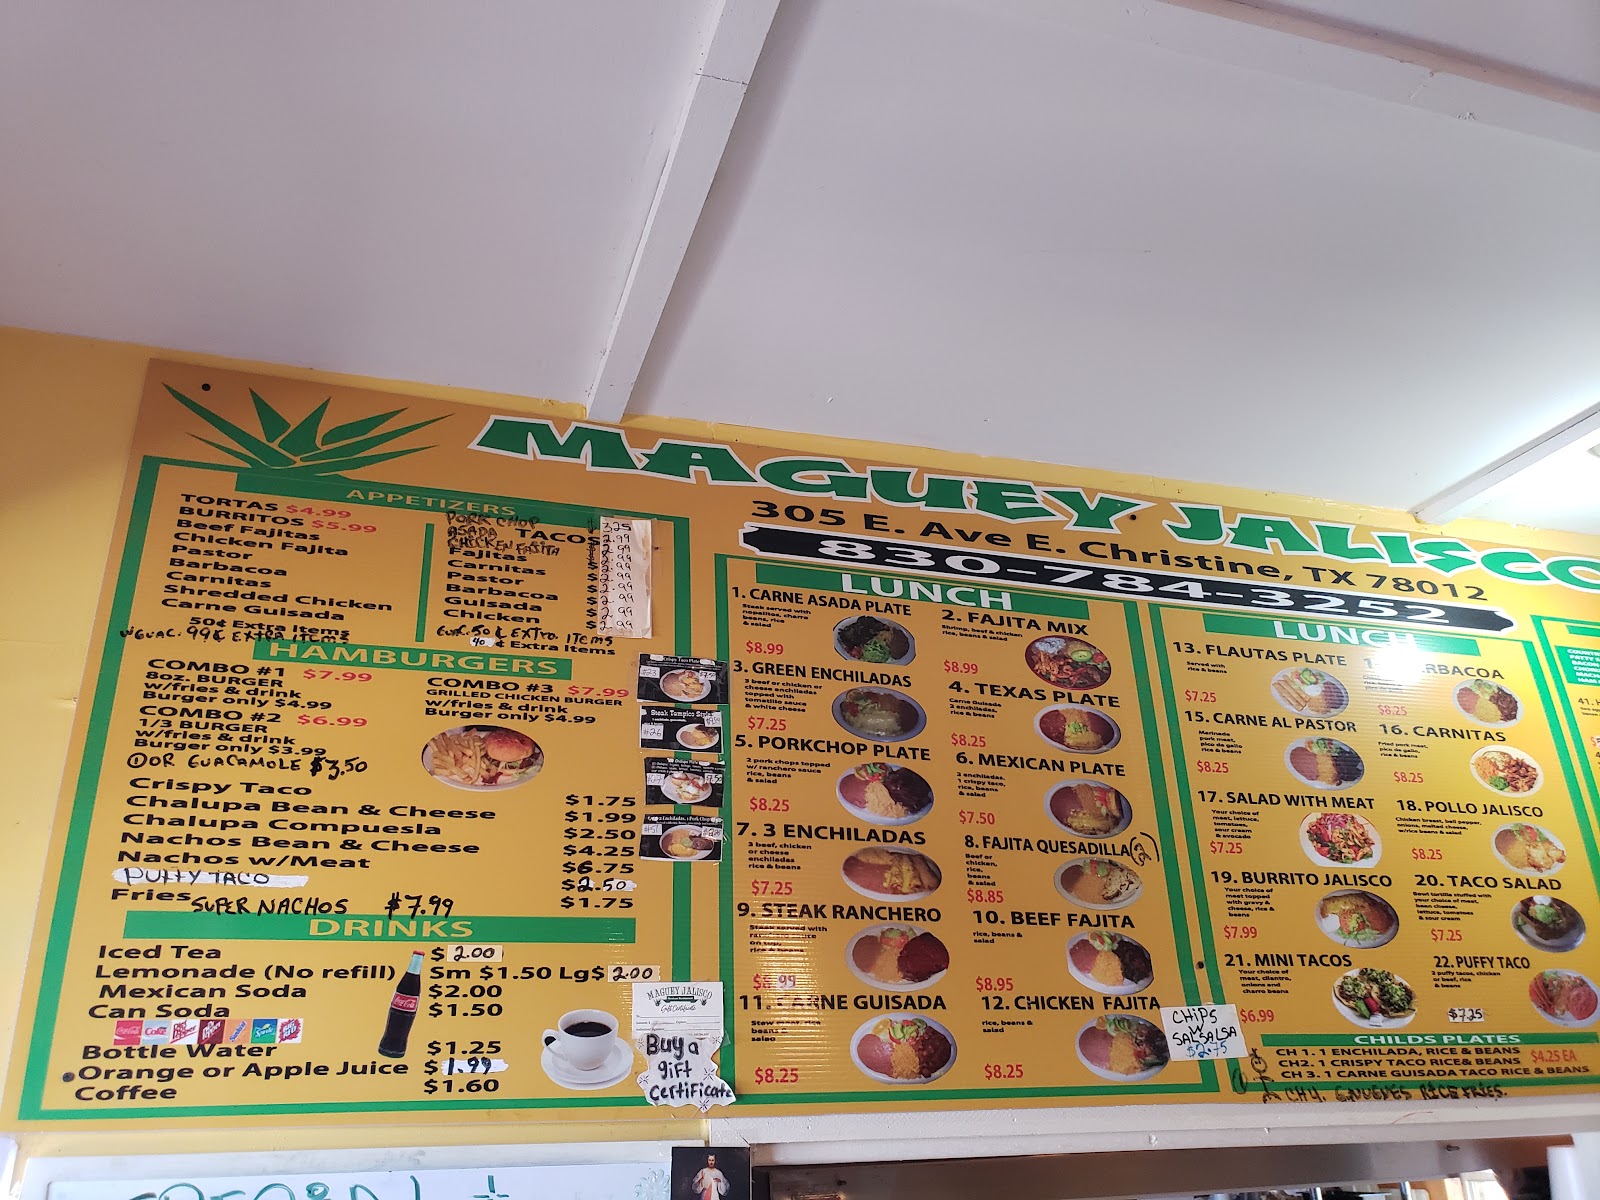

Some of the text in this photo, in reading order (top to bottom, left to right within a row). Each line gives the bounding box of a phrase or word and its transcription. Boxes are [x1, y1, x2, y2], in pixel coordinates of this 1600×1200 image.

[180, 493, 351, 518] TORTAS $4.99
[346, 489, 516, 516] APPETIZERS
[467, 414, 1600, 595] MAGUEY JALISCO
[179, 506, 377, 533] BURRITOS $5.99
[176, 519, 320, 541] Beef Fajitas
[172, 545, 252, 560] Pastor
[173, 532, 348, 556] Chicken Fajita
[750, 500, 1488, 601] 305 E. Ave E. Christine, TX 78012
[169, 558, 287, 576] Barbacoa
[447, 560, 546, 576] Carnitas
[166, 572, 271, 588] Carnitas
[446, 572, 524, 585] Pastor
[817, 538, 1451, 626] 830-784-3252
[163, 585, 392, 611] Shredded Chicken
[446, 584, 559, 601] Barbacoa
[841, 573, 1012, 611] LUNCH
[161, 598, 344, 621] Carne Guisada
[444, 597, 543, 611] Guisada
[732, 587, 912, 616] 1. CARNE ASADA PLATE
[443, 609, 540, 624] Chicken
[942, 609, 1089, 635] 2. FAJITA MIX
[1273, 620, 1418, 650] LUNCH
[746, 640, 784, 655] $8.99
[1173, 642, 1347, 666] 13. FLAUTAS PLATE
[269, 642, 557, 675] HAMBURGERS
[944, 660, 978, 674] $8.99
[148, 659, 372, 682] COMBO #1 $7.99
[733, 660, 748, 673] 3.
[752, 662, 806, 678] GREEN
[811, 667, 912, 687] ENCHILADAS
[146, 672, 284, 688] 8oz. BURGER
[427, 678, 629, 698] COMBO #3 $7.99
[144, 682, 218, 694] w/fries
[249, 688, 302, 698] drink
[426, 690, 622, 706] GRILLED CHICKEN BURGER
[1185, 690, 1217, 703] $7.25
[143, 691, 332, 710] Burger only $4.99
[748, 716, 787, 731] $7.25
[1379, 724, 1506, 742] 16. CARNITAS
[735, 735, 931, 761] 5. PORKCHOP PLATE
[188, 755, 301, 771] GUACAMOLE
[956, 752, 1126, 776] 6. MEXICAN PLATE
[130, 778, 636, 807] Crispy Taco $1.75
[1198, 791, 1374, 809] 17. SALAD WITH MEAT
[127, 796, 636, 823] Chalupa Bean & Cheese $1.99
[750, 797, 790, 812] $8.25
[959, 810, 995, 825] $7.50
[118, 851, 370, 868] Nachos w/Meat
[208, 871, 270, 885] TACO
[1211, 871, 1392, 887] 19. BURRITO JALISCO
[1414, 874, 1561, 890] 20. TACO SALAD
[111, 889, 191, 901] Fries
[191, 891, 454, 919] SUPER NACHOS $7.99
[308, 918, 473, 938] DRINKS
[973, 911, 1135, 928] 10. BEEF FAJITA
[1431, 928, 1462, 942] $7.25
[99, 945, 221, 959] Iced Tea
[1224, 954, 1352, 967] 21. MINI TACOS
[1434, 956, 1530, 969] 22. PUFFY TACO
[96, 965, 396, 981] Lemonade (No refill)
[99, 984, 502, 998] Mexican Soda $2.00
[976, 977, 1013, 991] $8.95
[982, 996, 1160, 1010] 12. CHICKEN FAJITA
[1240, 1009, 1275, 1023] $6.99
[1449, 1008, 1483, 1021] $7.25
[647, 1034, 699, 1060] Buy a
[1354, 1034, 1520, 1045] CHILDS PLATES
[82, 1040, 501, 1059] Bottle Water $1.25
[1276, 1046, 1520, 1057] CH 1. 1 ENCHILADA, RICE & BEANS
[1532, 1050, 1576, 1063] $4.25 EA
[242, 1061, 409, 1079] Apple Juice
[984, 1064, 1023, 1080] $8.25
[75, 1079, 499, 1100] Coffee $1.60
